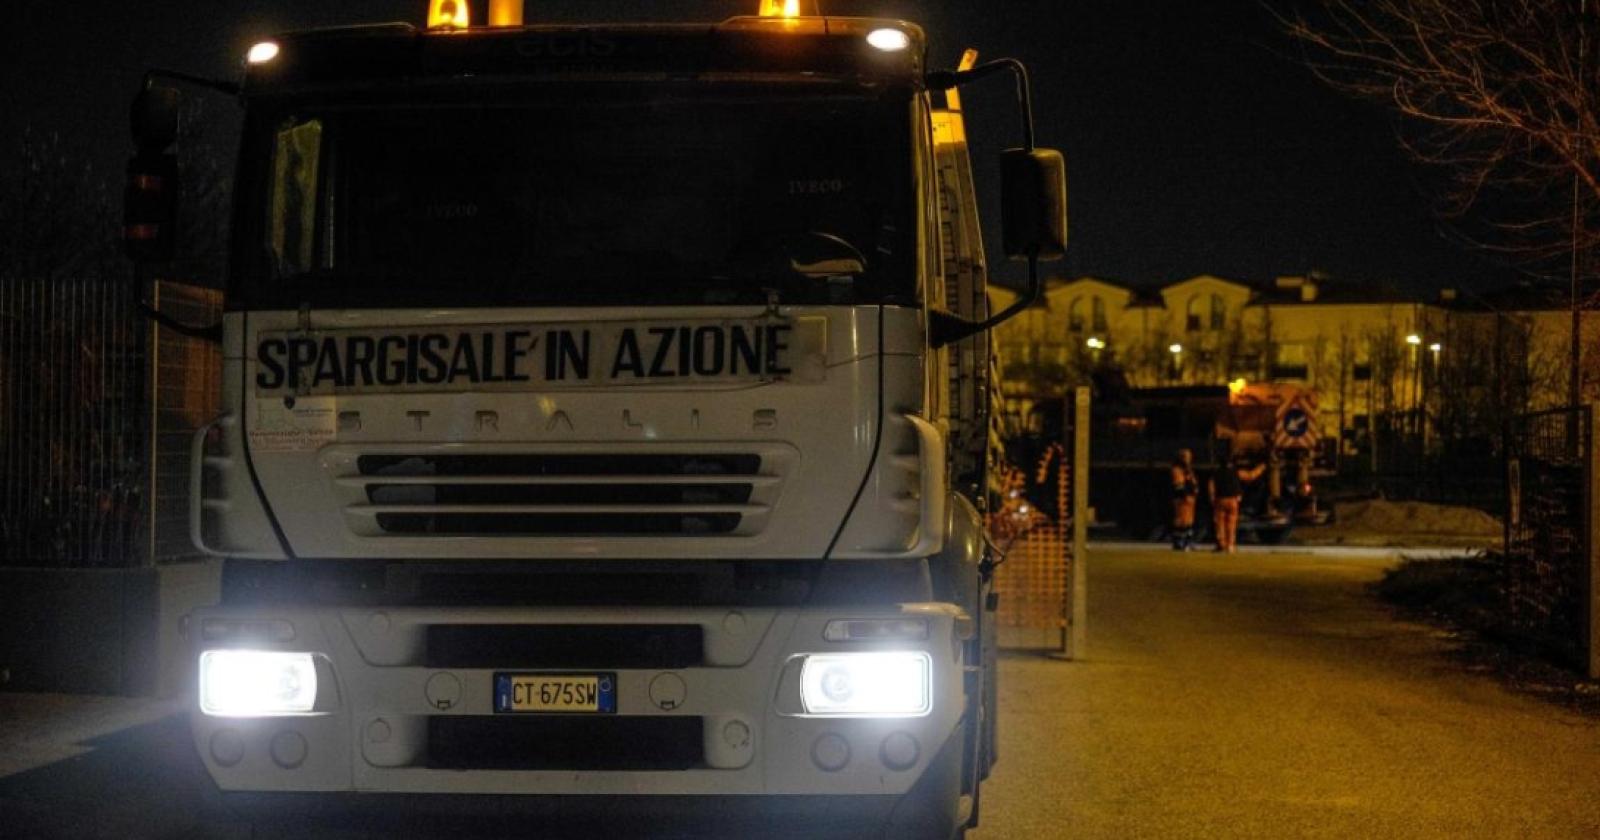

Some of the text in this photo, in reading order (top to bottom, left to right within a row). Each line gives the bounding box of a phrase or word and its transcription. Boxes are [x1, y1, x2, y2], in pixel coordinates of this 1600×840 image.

[787, 178, 843, 194] IVECO
[545, 330, 590, 381] IN
[610, 325, 792, 378] AZIONE
[337, 408, 777, 432] STRALIS
